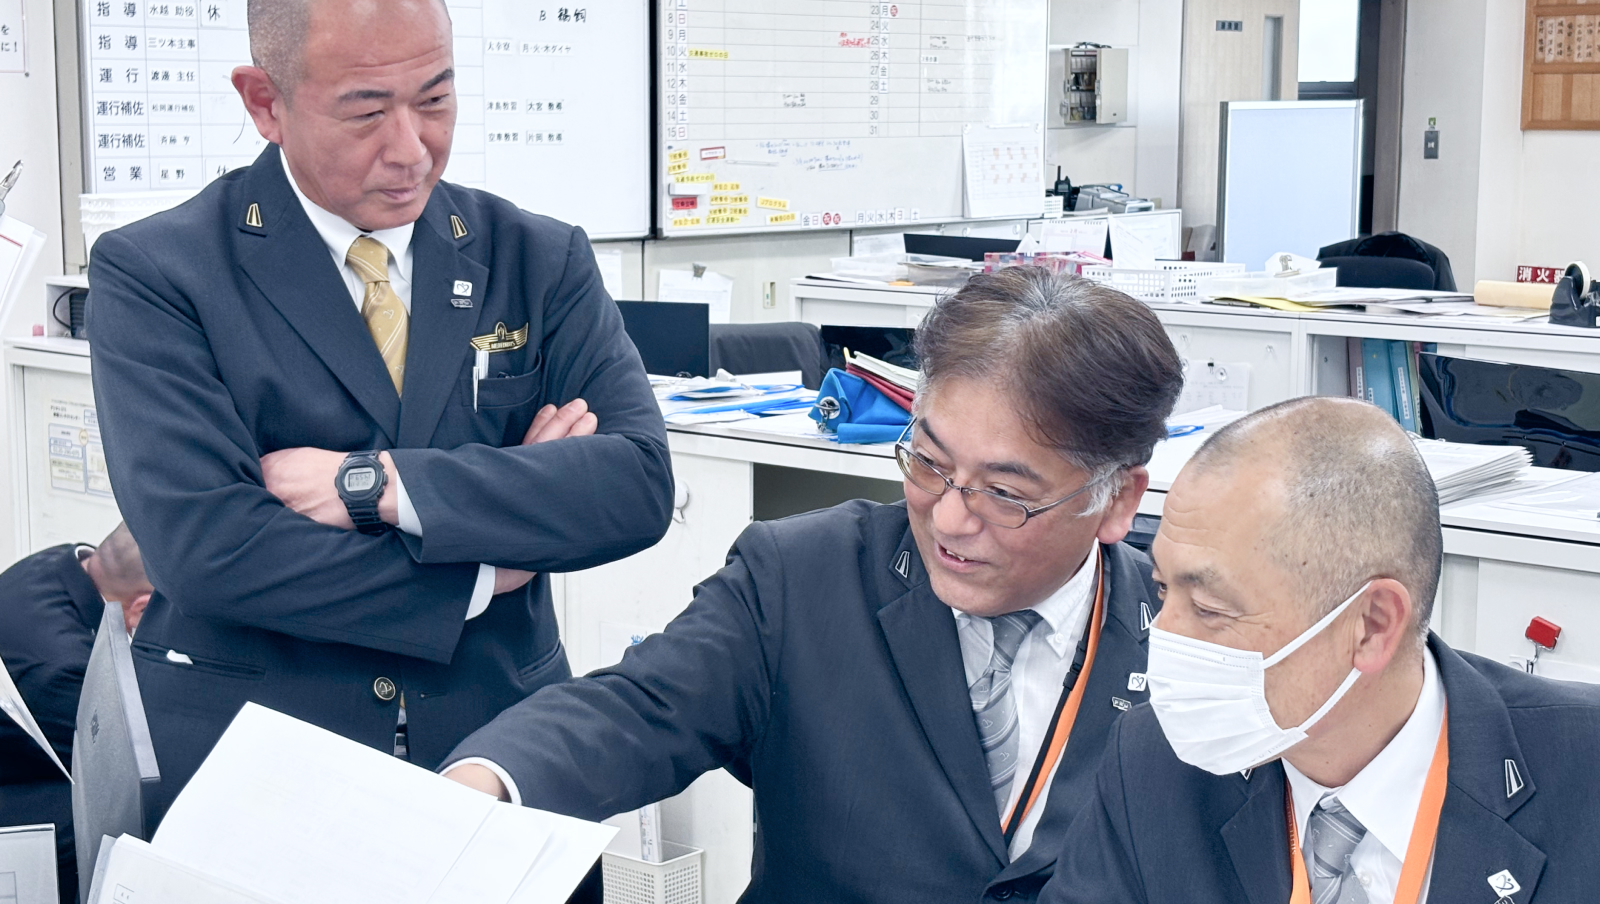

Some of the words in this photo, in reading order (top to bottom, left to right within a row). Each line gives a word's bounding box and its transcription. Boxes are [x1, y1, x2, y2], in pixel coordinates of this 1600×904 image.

[98, 2, 136, 17] 指導
[208, 5, 220, 20] 休
[882, 5, 889, 16] 月
[667, 13, 673, 24] 8
[678, 13, 686, 25] 日
[870, 19, 879, 31] 24
[881, 20, 889, 31] 火
[667, 29, 673, 40] 9
[678, 29, 687, 40] 月
[99, 35, 137, 50] 指導
[870, 35, 880, 46] 25
[881, 36, 888, 47] 水
[667, 46, 676, 56] 10
[678, 46, 687, 57] 火
[870, 51, 879, 61] 26
[880, 51, 888, 61] 木
[667, 61, 675, 72] 11
[678, 62, 687, 73] 水
[870, 66, 879, 76] 27
[880, 65, 887, 76] 金
[100, 68, 138, 83] 運行
[667, 78, 676, 88] 12
[678, 79, 687, 89] 木
[870, 80, 879, 91] 28
[667, 94, 676, 105] 13
[678, 94, 687, 105] 金
[870, 95, 878, 105] 29
[97, 101, 143, 115] 運行補佐
[667, 111, 676, 121] 14
[678, 111, 687, 121] 土
[870, 110, 878, 120] 30
[667, 127, 676, 137] 15
[678, 127, 686, 138] 日
[870, 125, 877, 135] 31
[99, 134, 144, 148] 運行補佐
[104, 166, 141, 180] 営業
